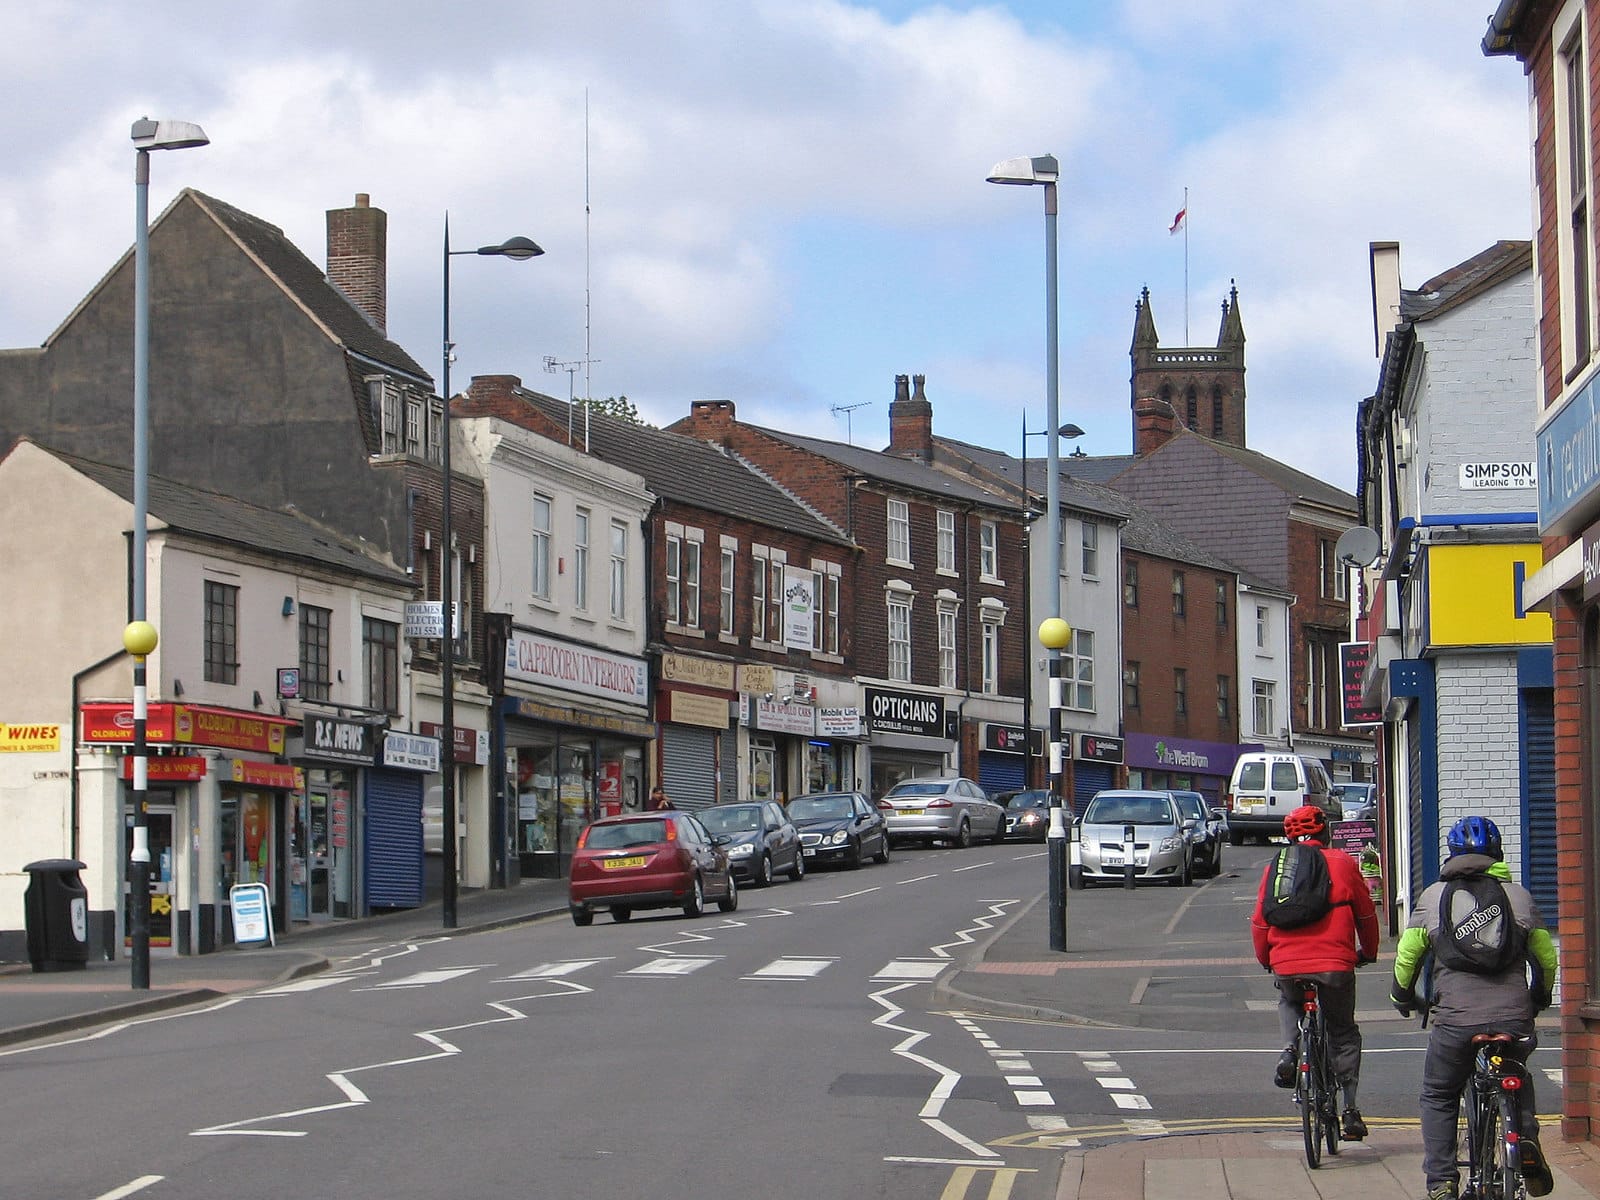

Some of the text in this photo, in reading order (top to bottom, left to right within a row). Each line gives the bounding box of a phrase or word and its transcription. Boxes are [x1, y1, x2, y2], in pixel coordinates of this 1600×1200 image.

[1560, 381, 1600, 501] recruit
[1465, 463, 1532, 478] SIMPSON
[1514, 478, 1524, 486] TO
[1529, 478, 1536, 487] M
[407, 604, 440, 614] HOLMES
[405, 626, 422, 635] 0121
[424, 626, 437, 635] 552
[518, 640, 580, 682] CAPRICORN
[581, 654, 636, 696] INTERIORS
[1354, 671, 1361, 679] G
[820, 706, 858, 716] Mobile Link
[872, 695, 937, 723] OPTICIANS
[197, 712, 236, 733] OLDBURY
[239, 719, 265, 737] WINES
[8, 726, 59, 739] WINES
[91, 730, 131, 738] OLDBURY
[314, 719, 364, 752] R.S. NEWS
[164, 764, 170, 772] &
[174, 764, 200, 772] WINE
[33, 771, 47, 779] LOW
[1454, 904, 1502, 940] umbro
